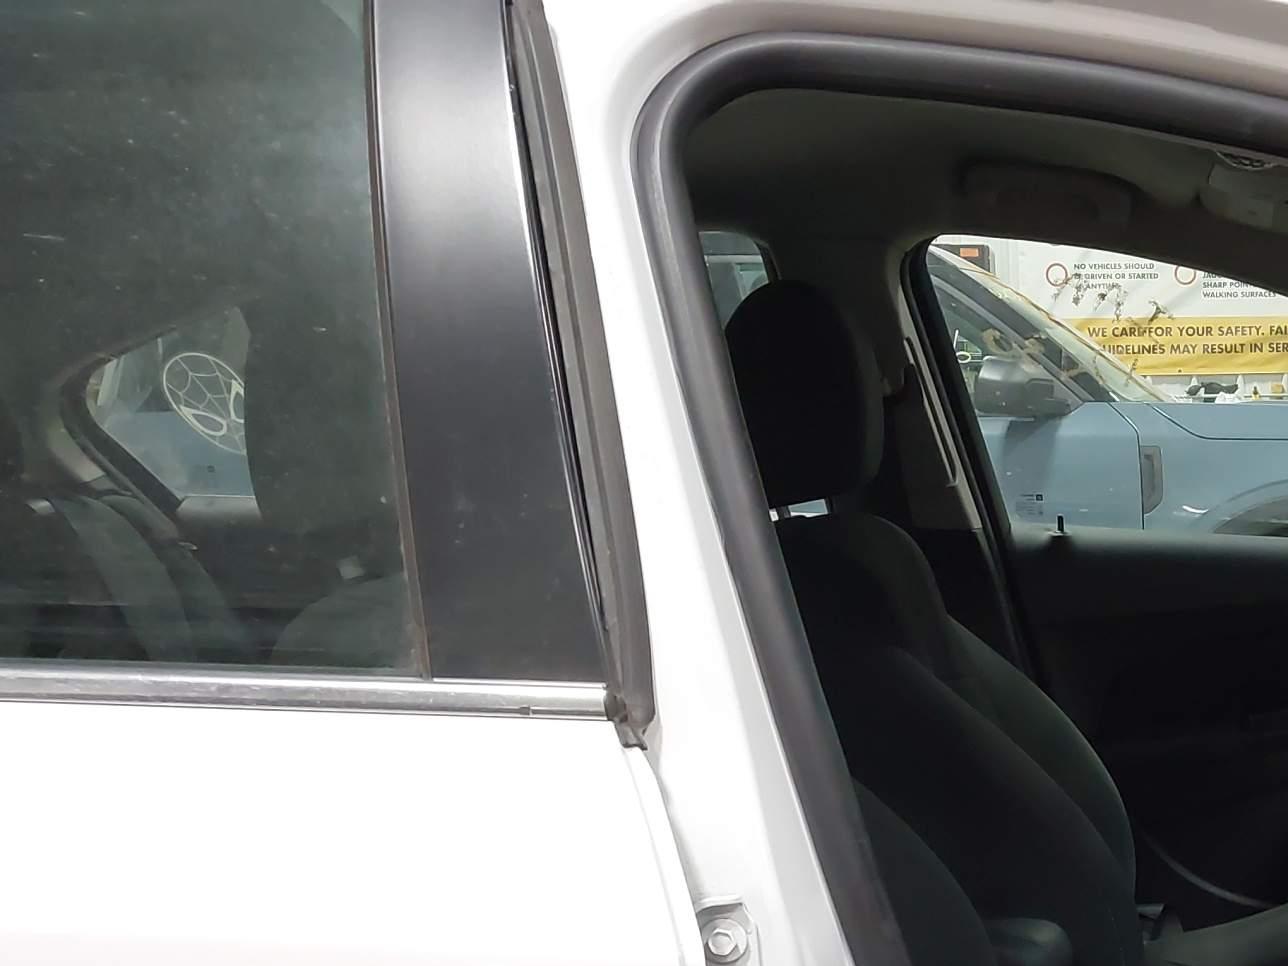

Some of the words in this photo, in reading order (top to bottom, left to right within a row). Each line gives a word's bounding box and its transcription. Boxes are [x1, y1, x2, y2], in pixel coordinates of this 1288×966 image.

[1202, 281, 1228, 289] SHARP
[1229, 281, 1249, 289] POIN
[1087, 327, 1108, 337] WE
[1111, 326, 1144, 337] CARE
[1149, 326, 1173, 337] FOR
[1177, 326, 1213, 337] YOUR
[1218, 325, 1265, 337] SAFETY.
[1102, 344, 1166, 355] UIDELINES
[1169, 344, 1198, 354] MAY
[1202, 343, 1246, 354] RESULT
[1249, 343, 1264, 353] IN
